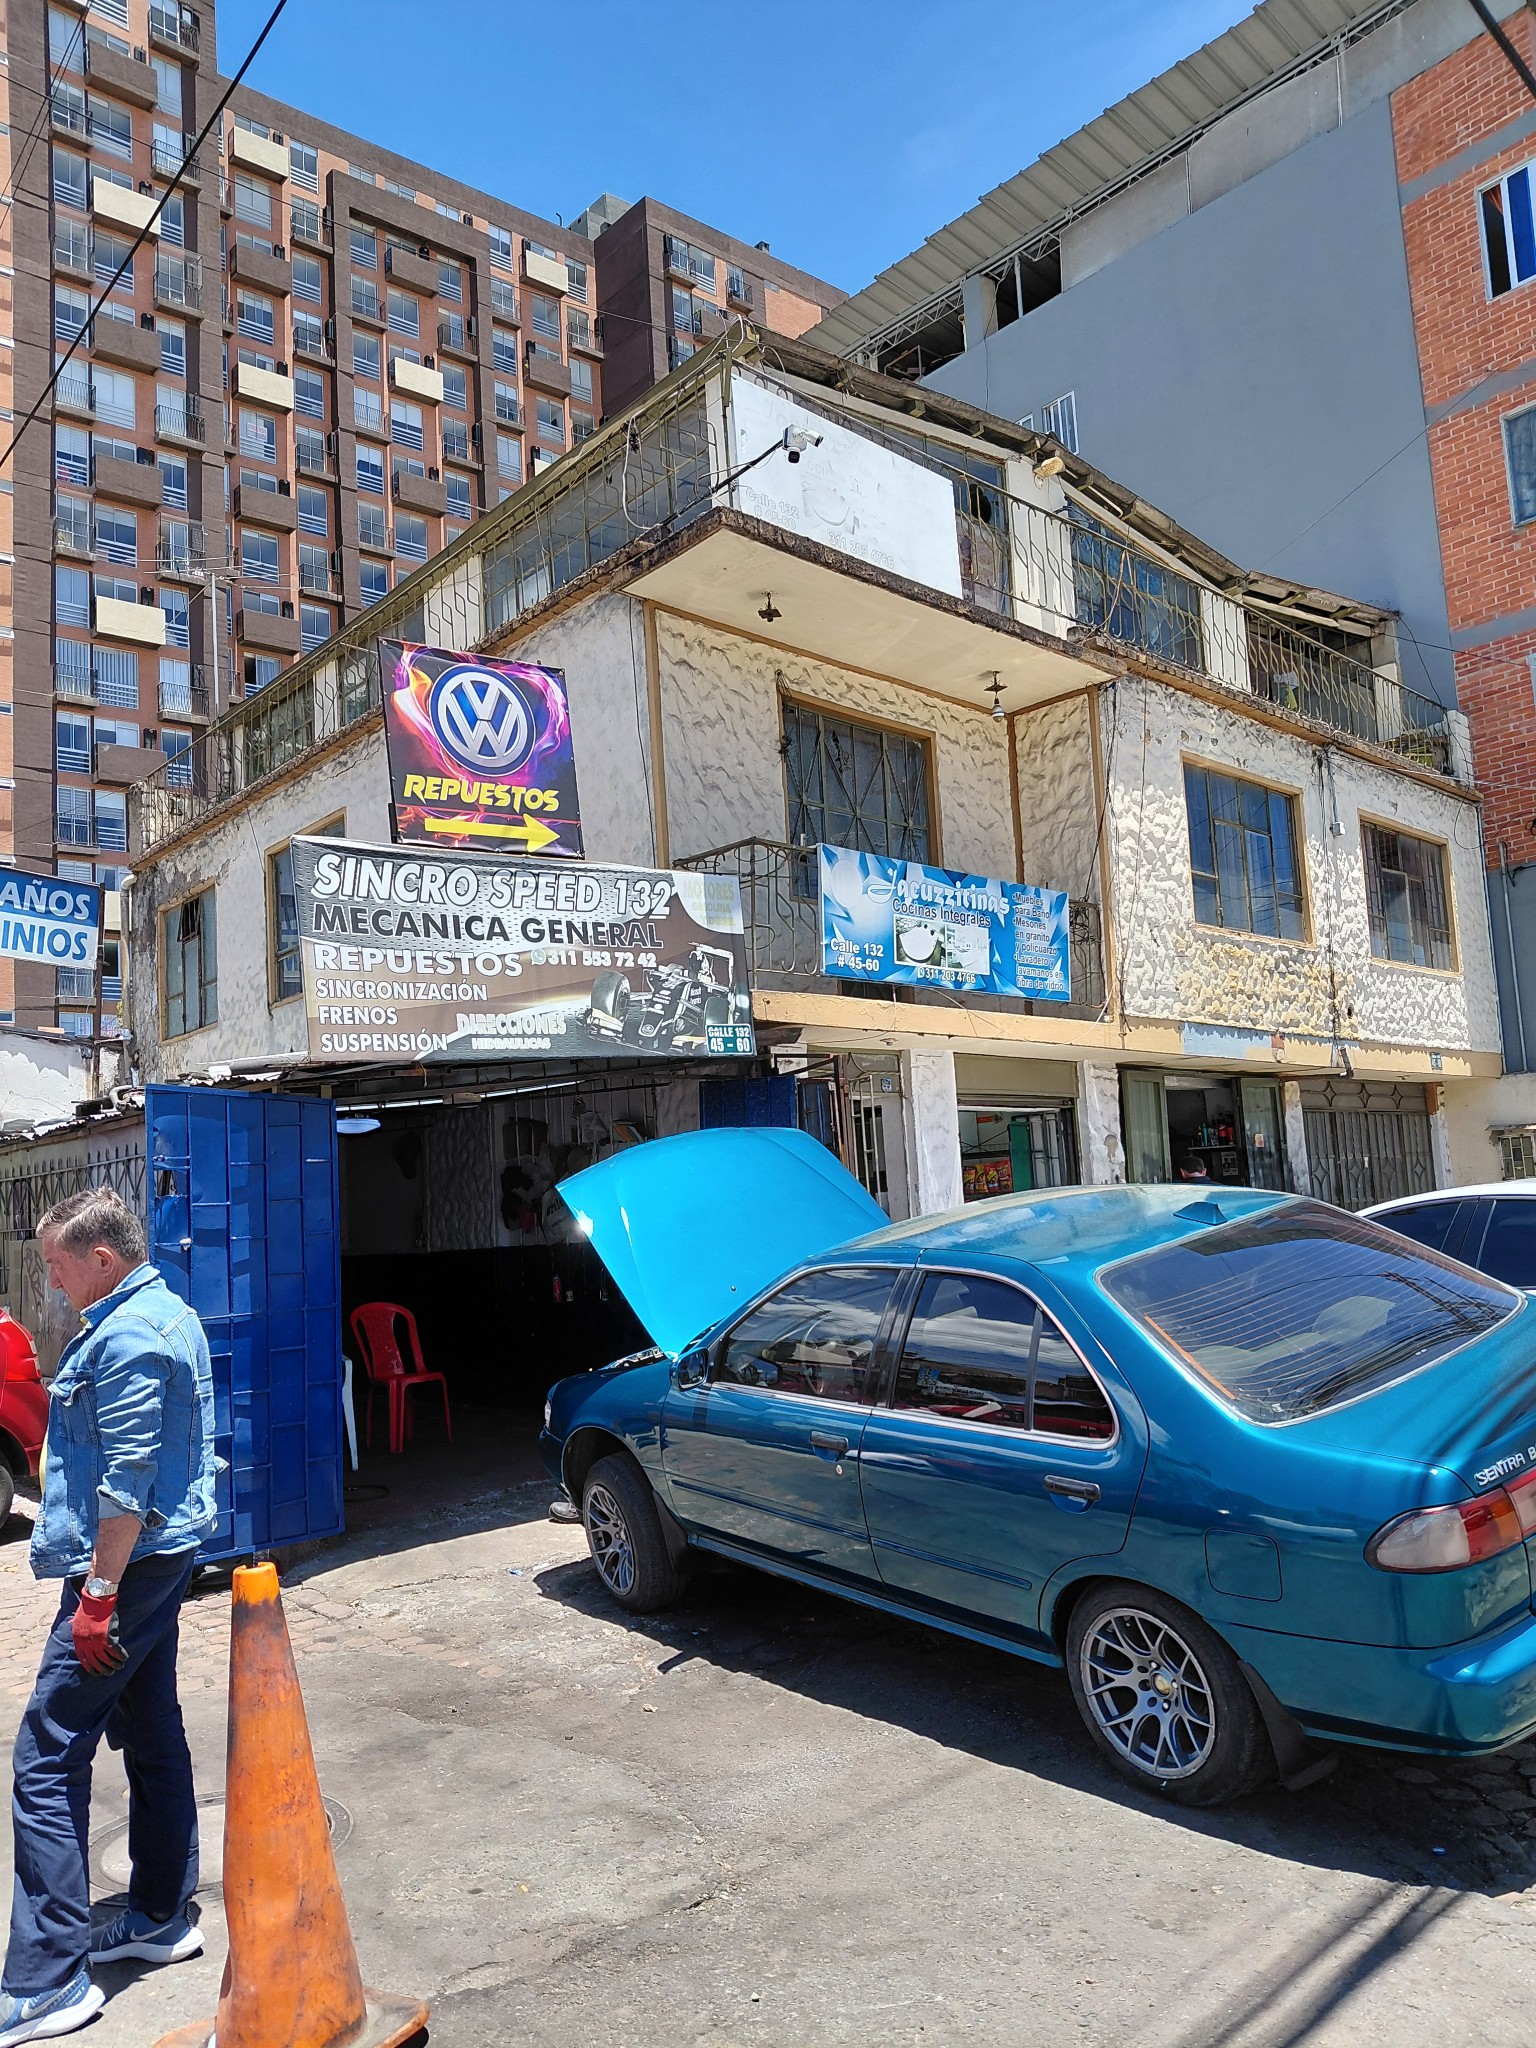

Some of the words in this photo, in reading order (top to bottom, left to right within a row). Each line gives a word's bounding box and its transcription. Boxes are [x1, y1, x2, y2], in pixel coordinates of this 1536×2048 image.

[779, 501, 800, 519] 132
[404, 774, 560, 813] REPUESTOS
[311, 853, 480, 906] SINCRO
[489, 868, 602, 912] SPEED
[613, 878, 673, 919] 132
[868, 868, 1010, 915] Jacuzzitinas
[1015, 892, 1044, 907] Muebles
[892, 898, 938, 919] Cocinas
[940, 905, 992, 927] Integrales
[1015, 906, 1031, 917] para
[1032, 907, 1050, 919] Baño
[312, 902, 511, 943] MECANICA
[520, 917, 664, 949] GENERAL
[1015, 916, 1047, 931] Mesones
[1015, 930, 1025, 938] en
[1025, 931, 1050, 943] granito
[830, 938, 860, 953] Calle
[863, 943, 885, 957] 132
[1021, 942, 1057, 955] policuarzo
[313, 943, 524, 978] REPUESTOS
[547, 949, 577, 966] 311
[582, 950, 612, 967] 553
[614, 951, 635, 968] 72
[637, 952, 657, 968] 42
[848, 957, 880, 972] 45-60
[1016, 953, 1049, 966] Lavadero
[925, 967, 940, 979] 311
[941, 969, 956, 981] 203
[957, 971, 977, 984] 4766
[1016, 964, 1053, 979] lavamanos
[315, 977, 488, 1001] SINCRONIZACIÓN
[1016, 977, 1034, 988] fibra
[1035, 978, 1044, 988] de
[1044, 980, 1064, 991] vidrio
[318, 1005, 399, 1026] FRENOS
[456, 1013, 567, 1036] DIRECCIONES
[708, 1026, 735, 1037] CALLE
[735, 1027, 750, 1037] 132
[320, 1028, 448, 1053] SUSPENSIÓN
[471, 1037, 552, 1050] HIDRAULICAS
[710, 1037, 725, 1052] 45
[736, 1037, 751, 1052] 60
[1474, 1452, 1526, 1486] SENTRA
